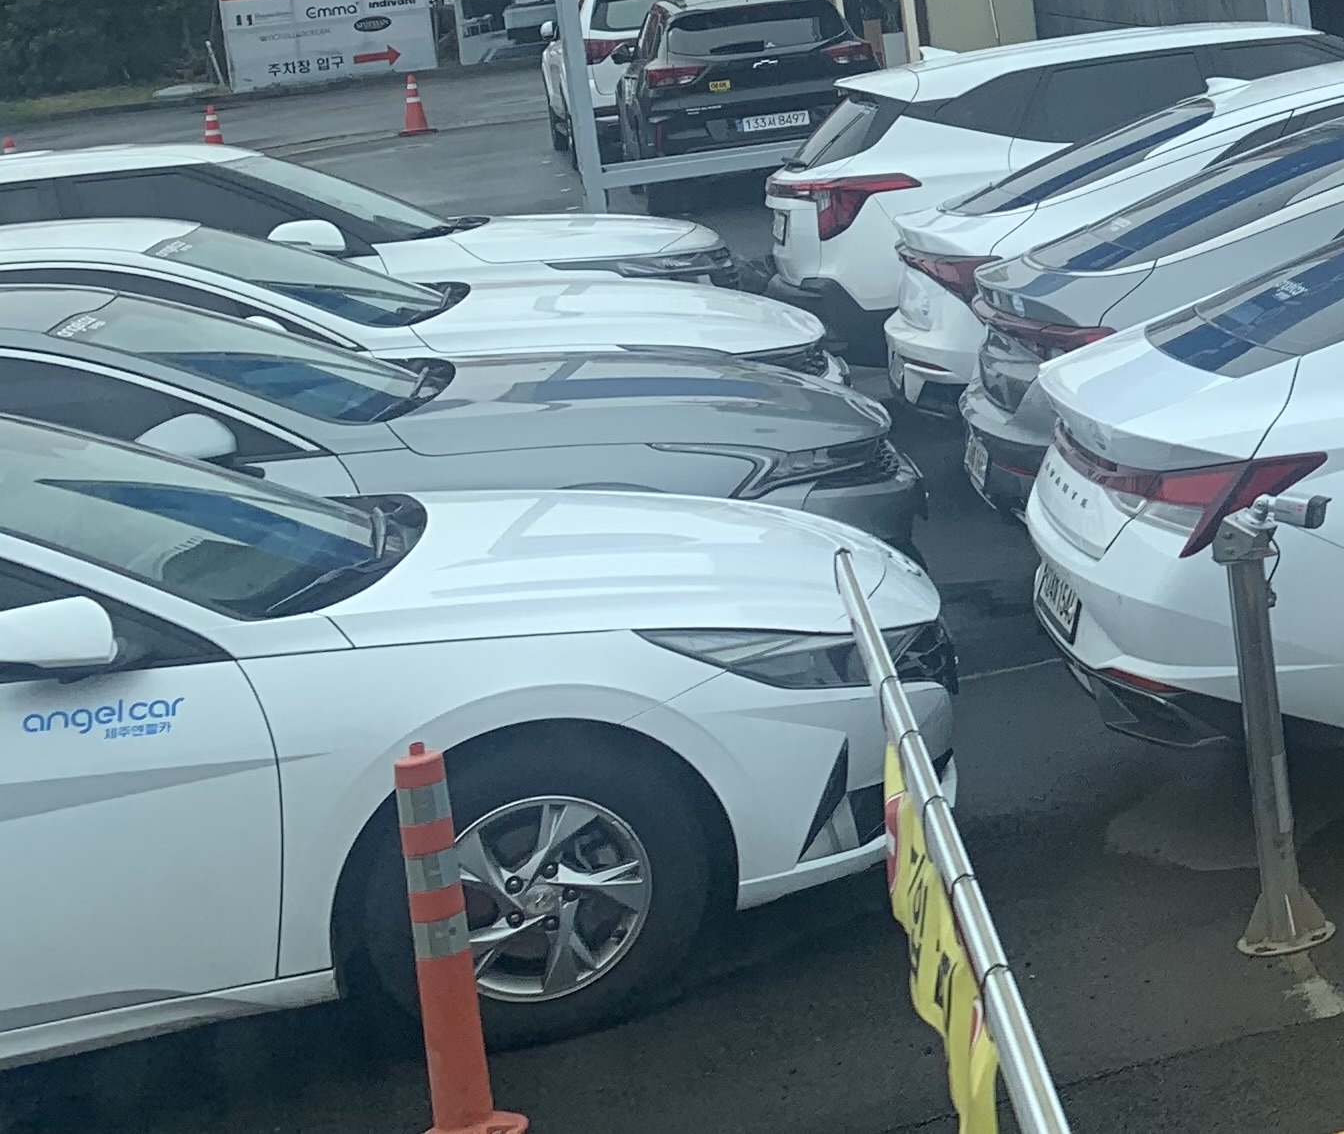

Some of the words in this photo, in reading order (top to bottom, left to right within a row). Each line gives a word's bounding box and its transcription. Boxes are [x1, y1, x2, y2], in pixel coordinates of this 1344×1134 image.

[267, 59, 311, 78] 주차장
[316, 55, 345, 71] 입구
[1045, 461, 1089, 509] AVANTE
[104, 721, 173, 739] 제주엔젤카
